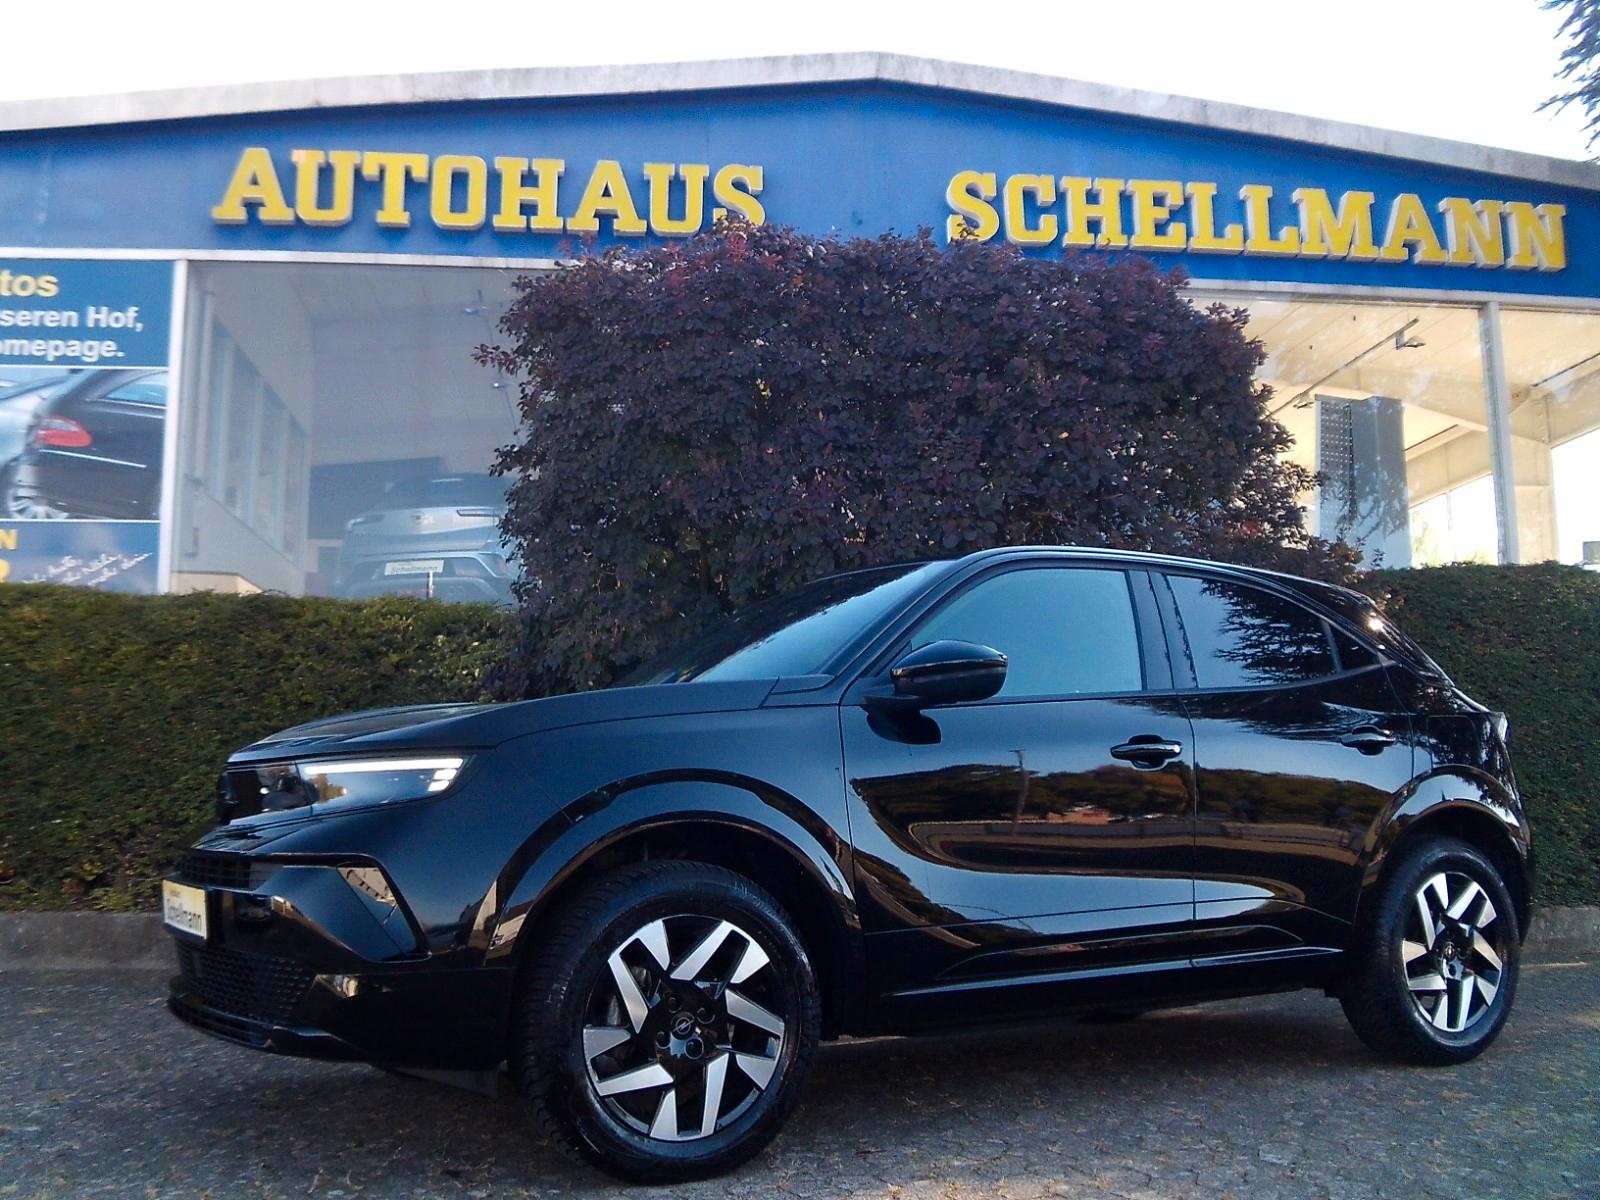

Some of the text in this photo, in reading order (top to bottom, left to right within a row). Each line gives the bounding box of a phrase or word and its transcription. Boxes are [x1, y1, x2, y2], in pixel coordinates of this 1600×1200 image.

[211, 147, 1567, 272] AUTOHAUS SCHELLMANN
[0, 306, 144, 332] seren Hof,
[0, 339, 125, 362] mepage.
